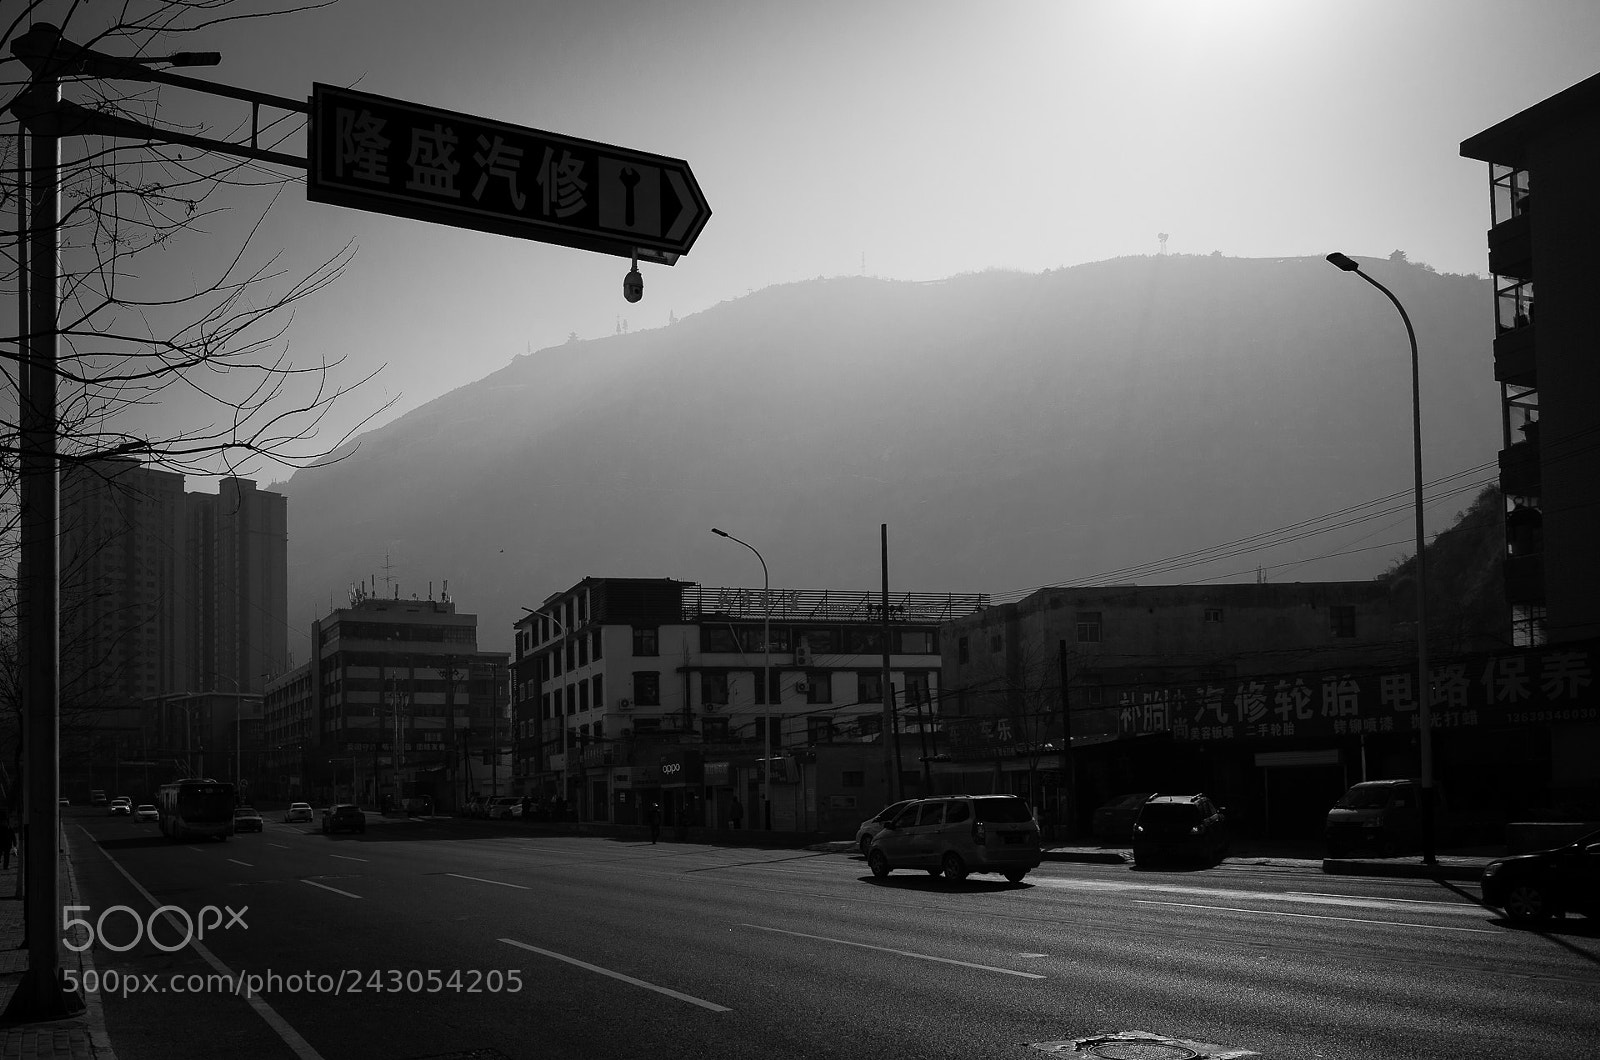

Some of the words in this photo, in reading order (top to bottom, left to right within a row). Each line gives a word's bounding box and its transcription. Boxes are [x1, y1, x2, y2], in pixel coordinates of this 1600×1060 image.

[334, 106, 589, 220] 隆盛汽修
[1194, 673, 1360, 723] 汽修轮胎
[1380, 651, 1593, 711] 电路保养
[1245, 721, 1295, 737] 二手轮胎
